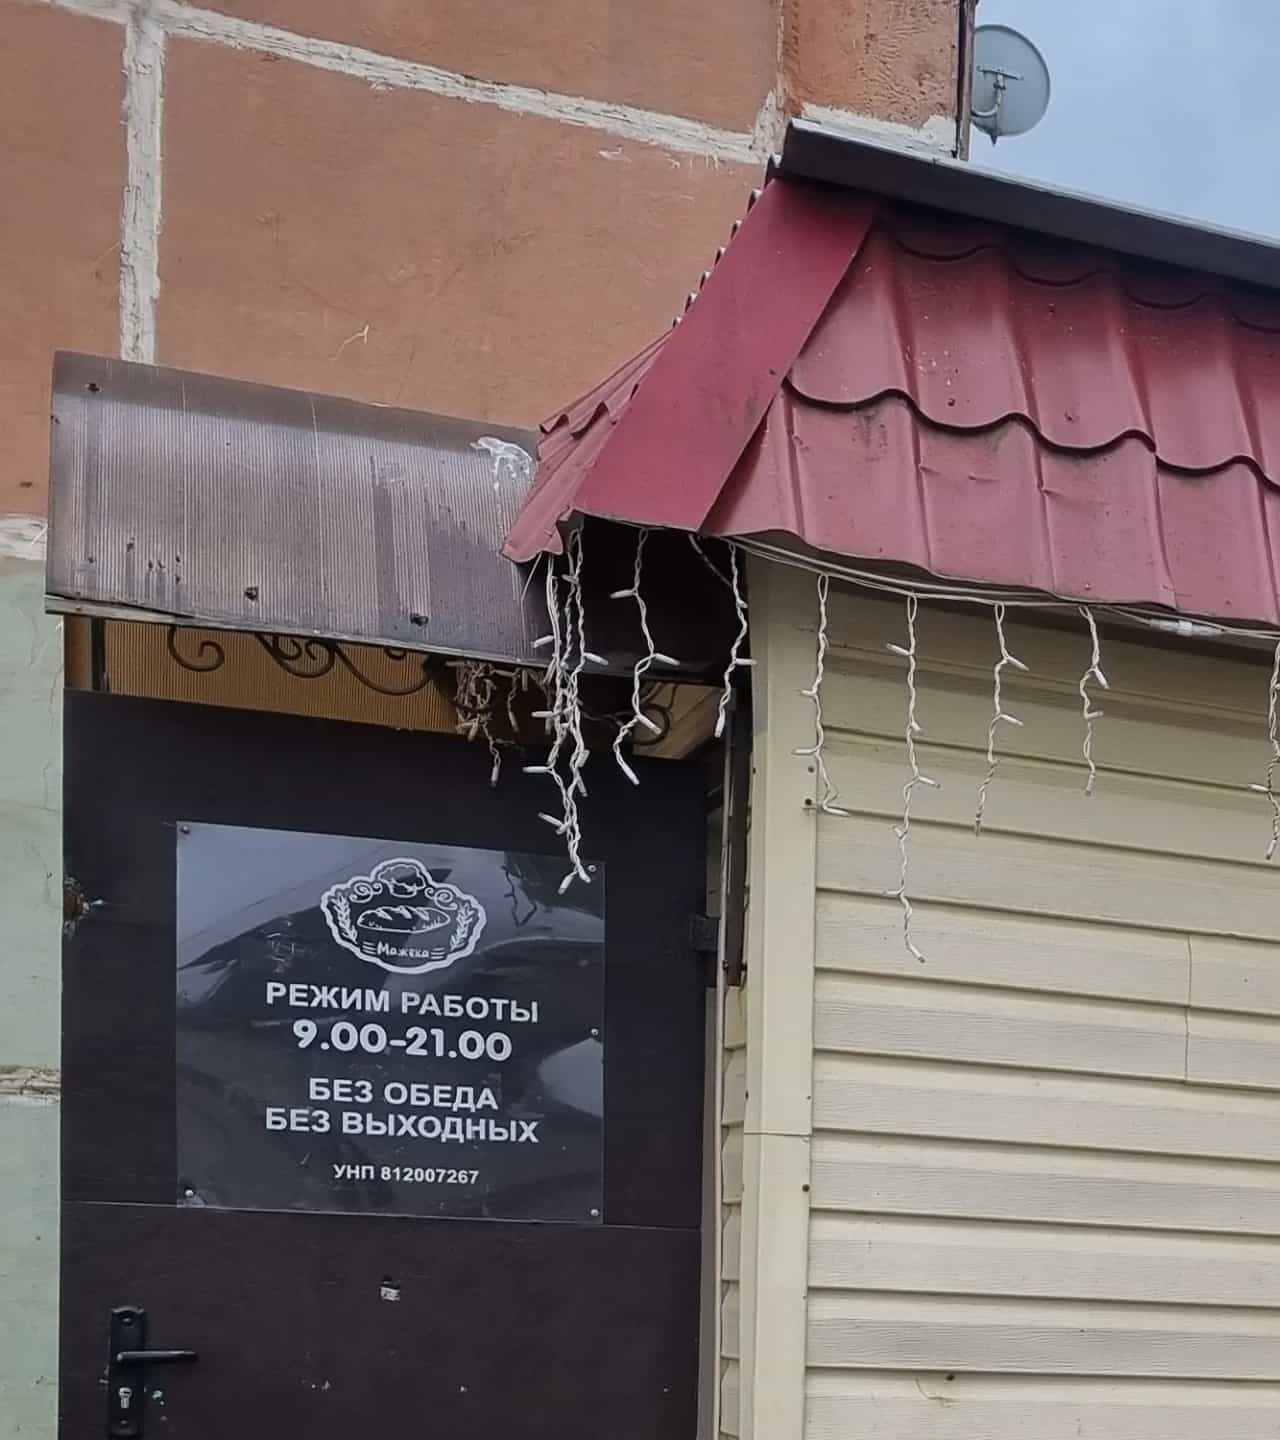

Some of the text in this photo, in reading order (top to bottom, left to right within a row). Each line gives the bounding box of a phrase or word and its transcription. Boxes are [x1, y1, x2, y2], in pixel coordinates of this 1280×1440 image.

[265, 981, 539, 1023] РЕЖИМ РАБОТЫ
[292, 1018, 513, 1062] 9.00-21.00
[308, 1077, 499, 1113] БЕЗ ОБЕДА
[265, 1107, 540, 1143] БЕЗ ВЫХОДНЫХ
[332, 1163, 480, 1185] УНП 812007267
